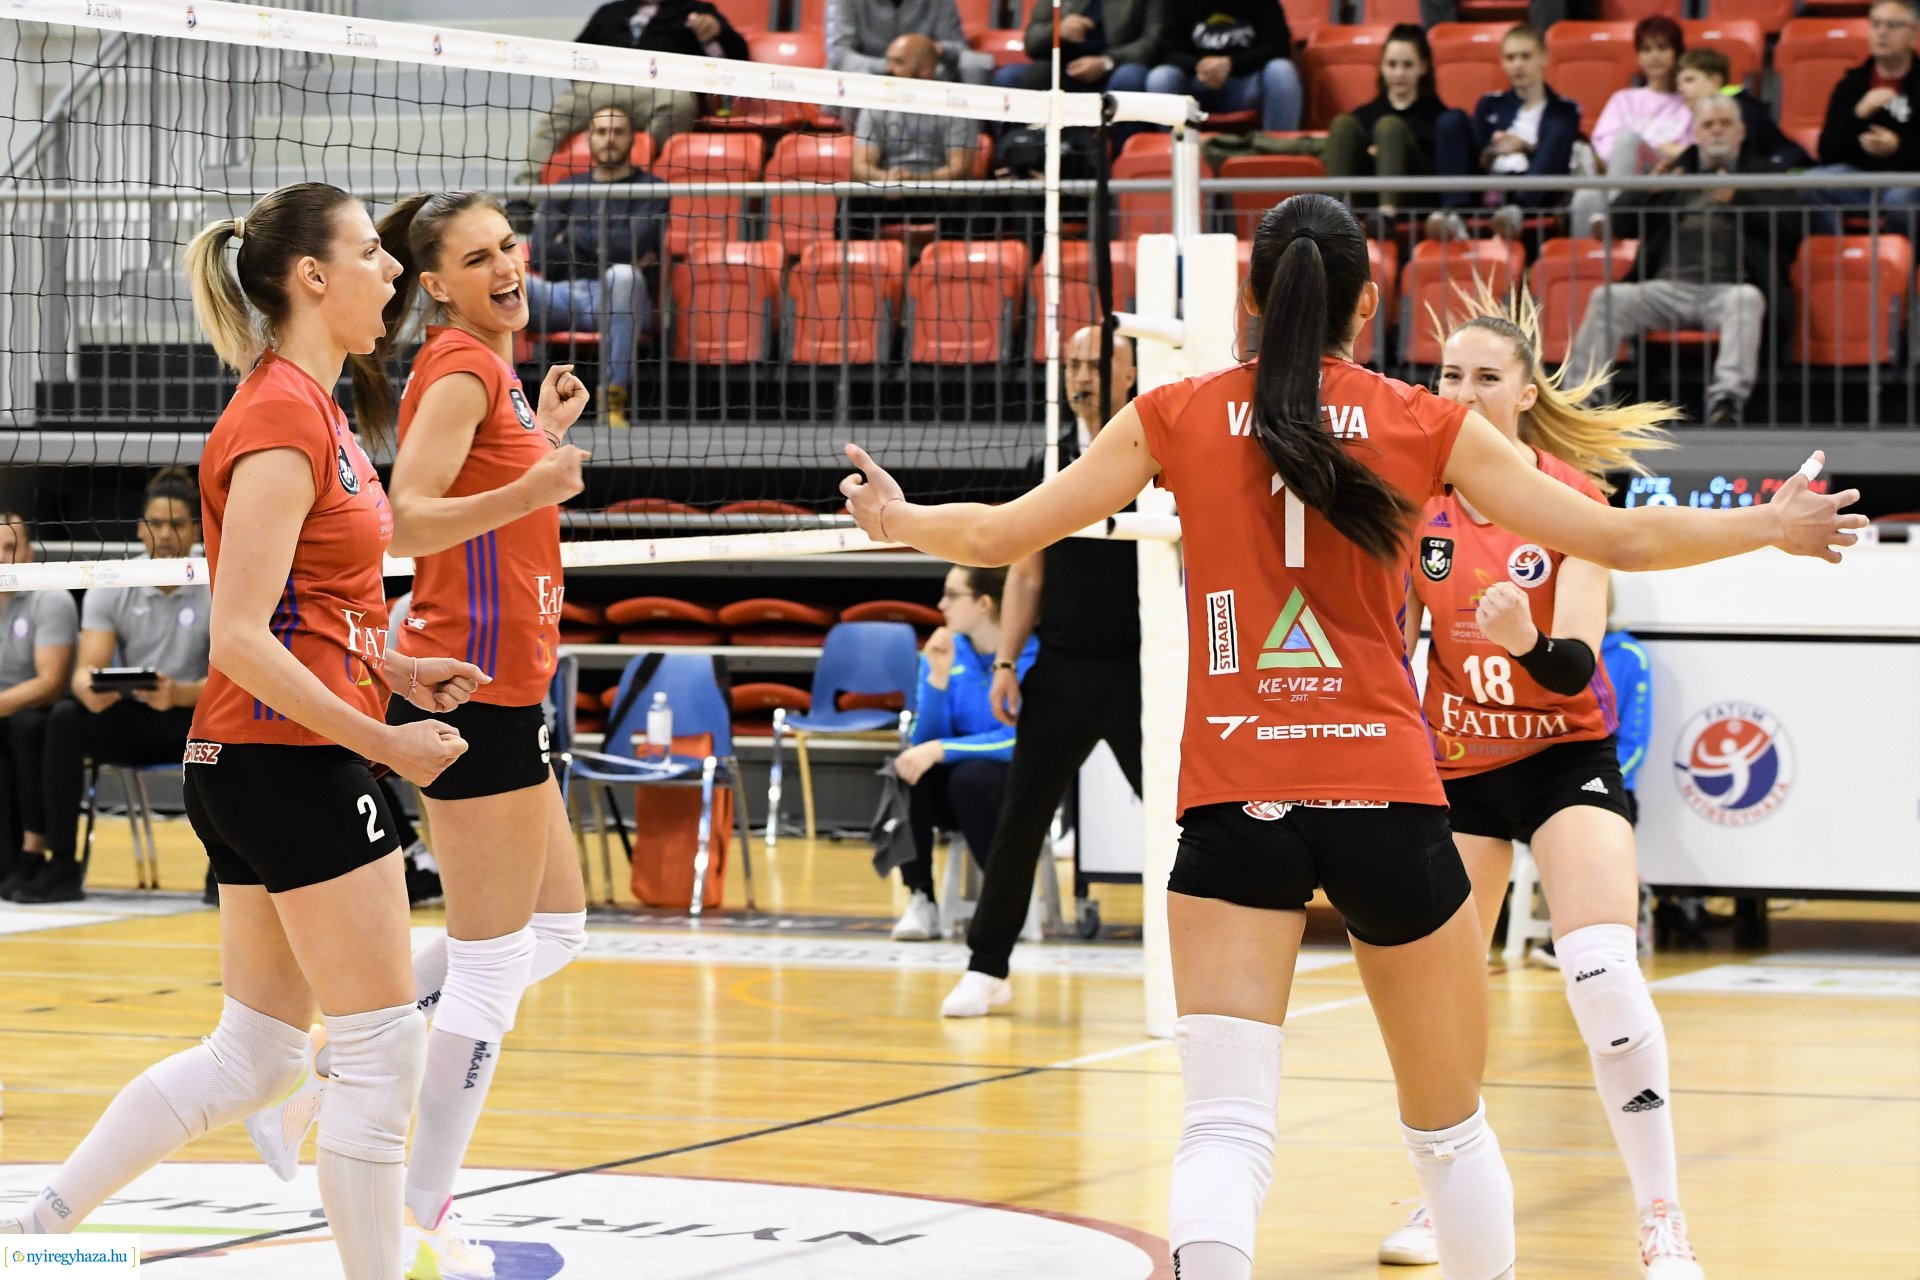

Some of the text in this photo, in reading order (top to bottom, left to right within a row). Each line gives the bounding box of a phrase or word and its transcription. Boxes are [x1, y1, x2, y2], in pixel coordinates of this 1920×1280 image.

[1271, 471, 1305, 568] 1
[1216, 595, 1231, 670] STRABAG
[1258, 677, 1343, 694] KE-VIZ 21
[1290, 694, 1309, 702] ZRT.
[1463, 655, 1515, 706] 18
[1256, 723, 1387, 740] BESTRONG
[1442, 692, 1568, 739] FATUM
[356, 793, 385, 843] 2
